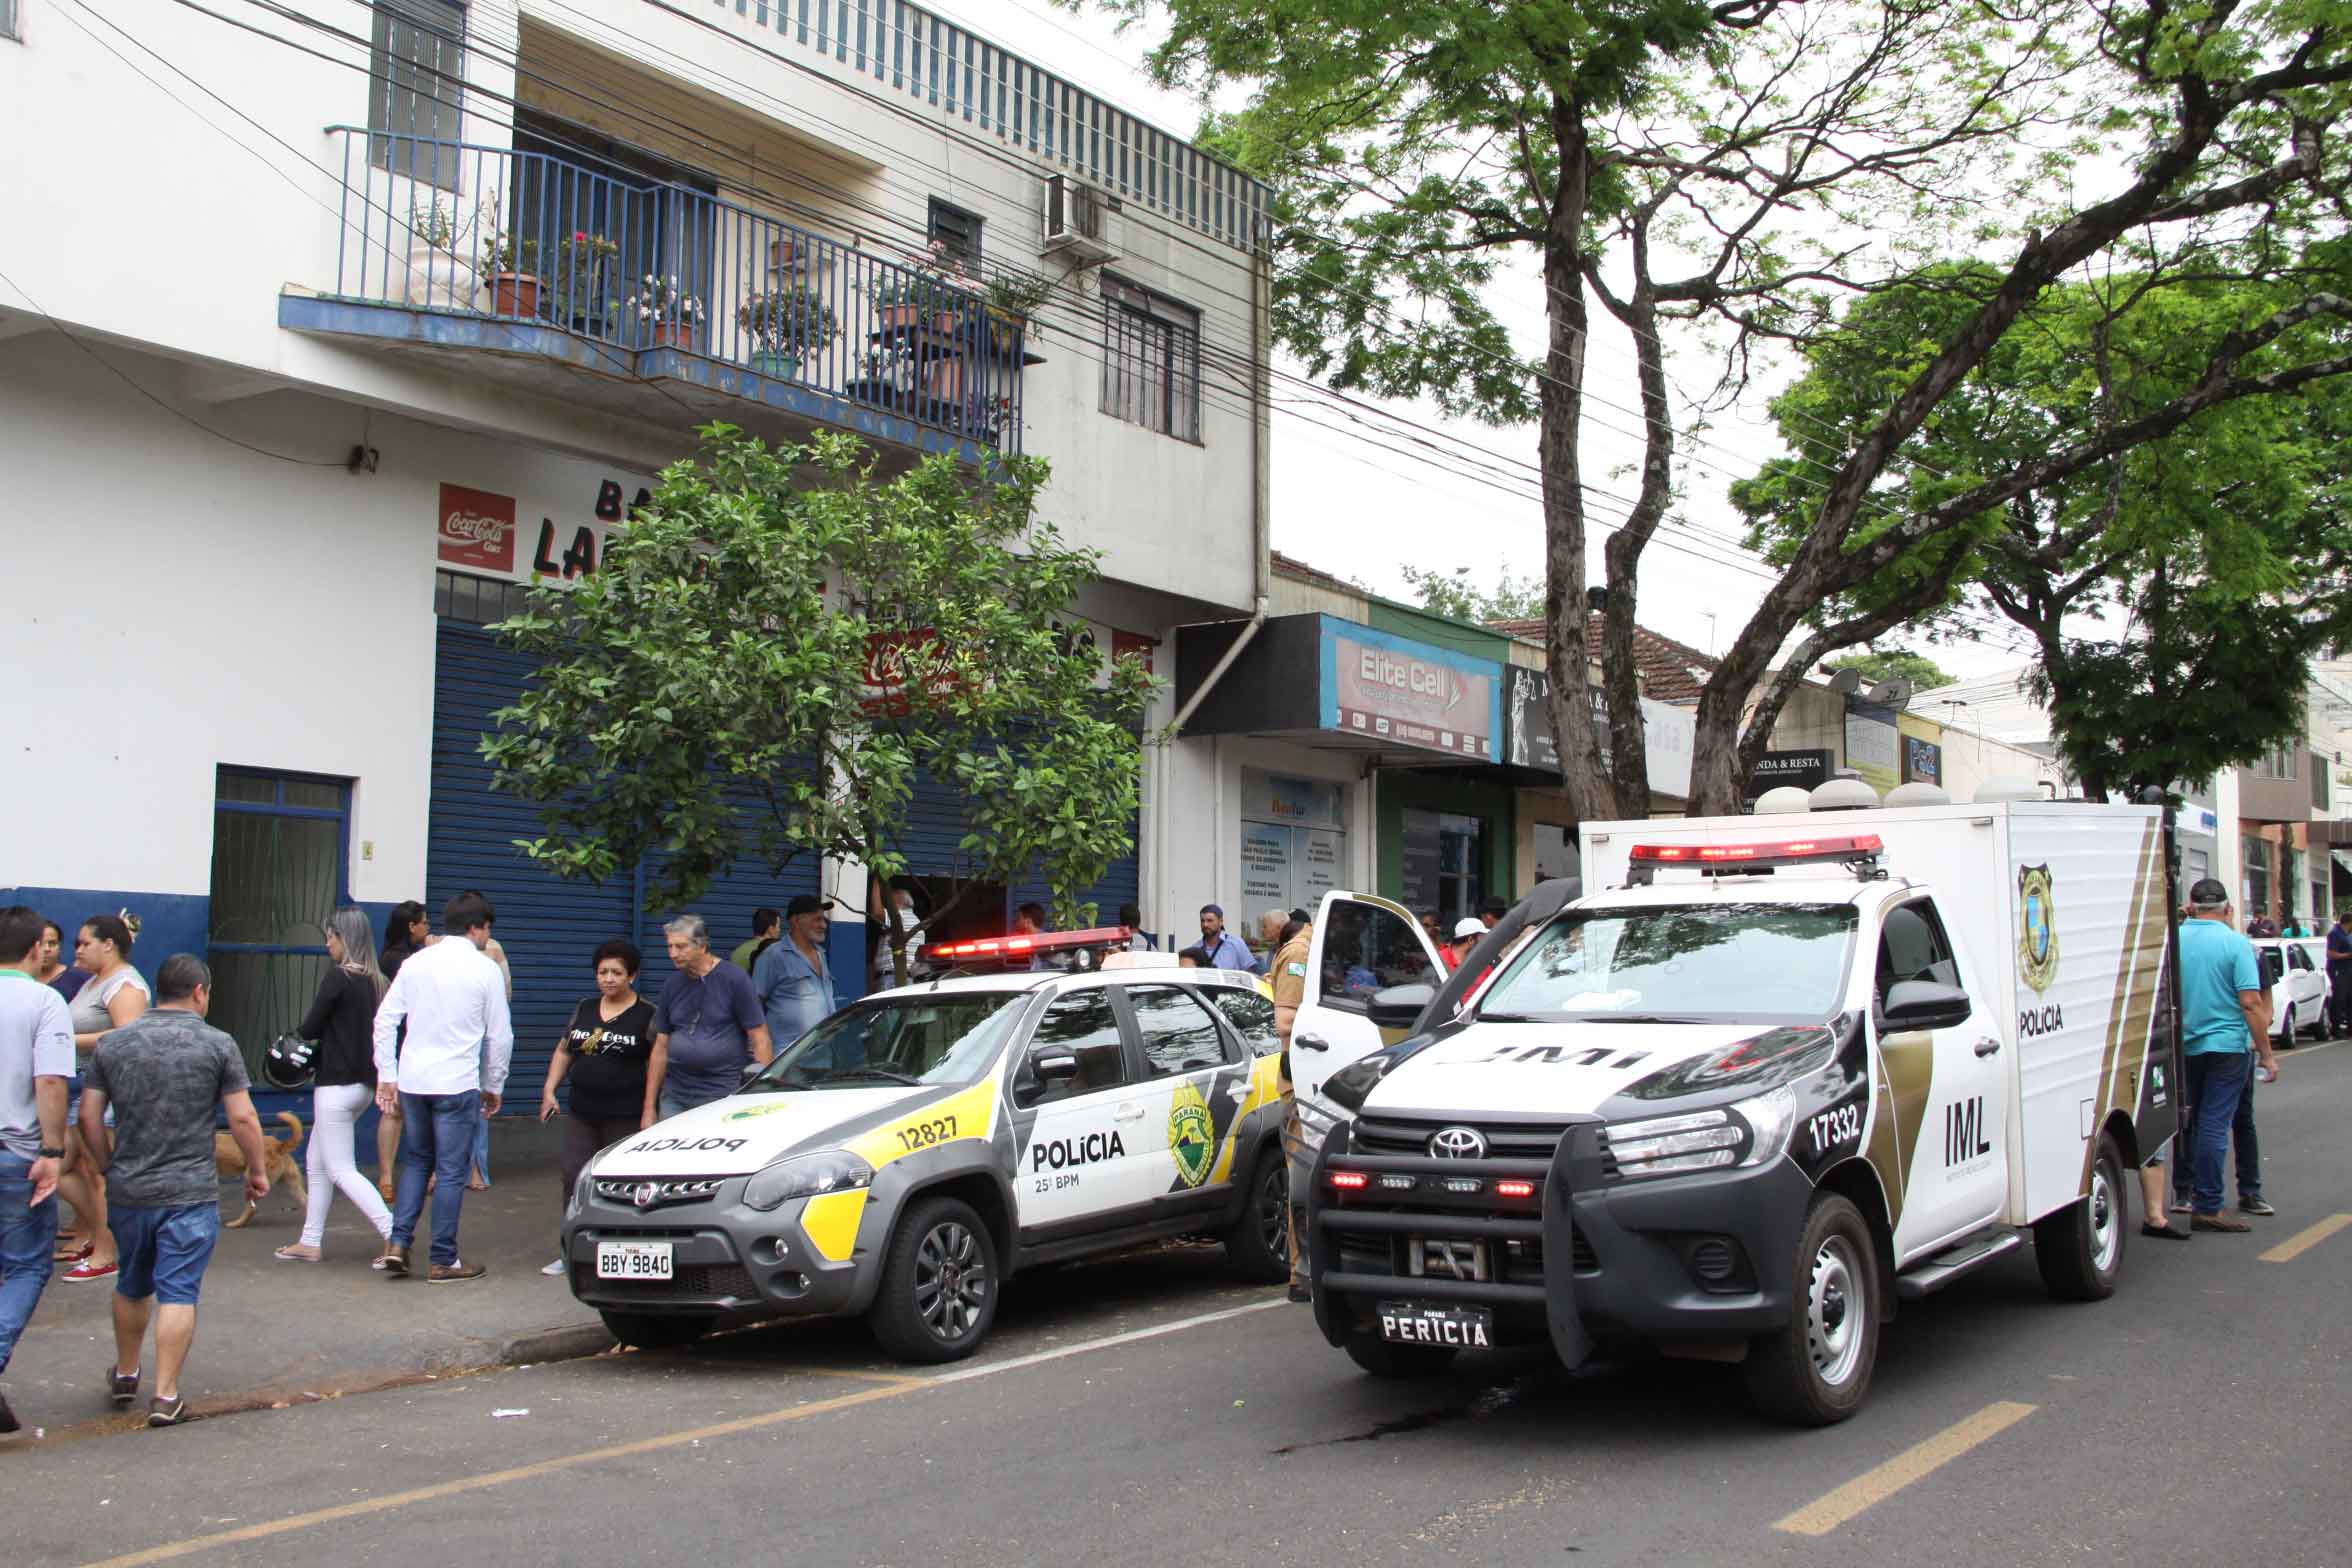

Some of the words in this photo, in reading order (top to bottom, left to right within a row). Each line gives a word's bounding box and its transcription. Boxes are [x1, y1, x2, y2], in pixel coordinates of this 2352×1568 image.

[1360, 648, 1406, 690] Elite
[1410, 663, 1445, 697] Cell
[1780, 759, 1788, 769] &
[602, 1031, 636, 1046] Best
[896, 1115, 957, 1150] 12827
[1809, 1103, 1860, 1151] 17332
[1946, 1095, 1990, 1167] IML
[1056, 1174, 1080, 1189] BPM
